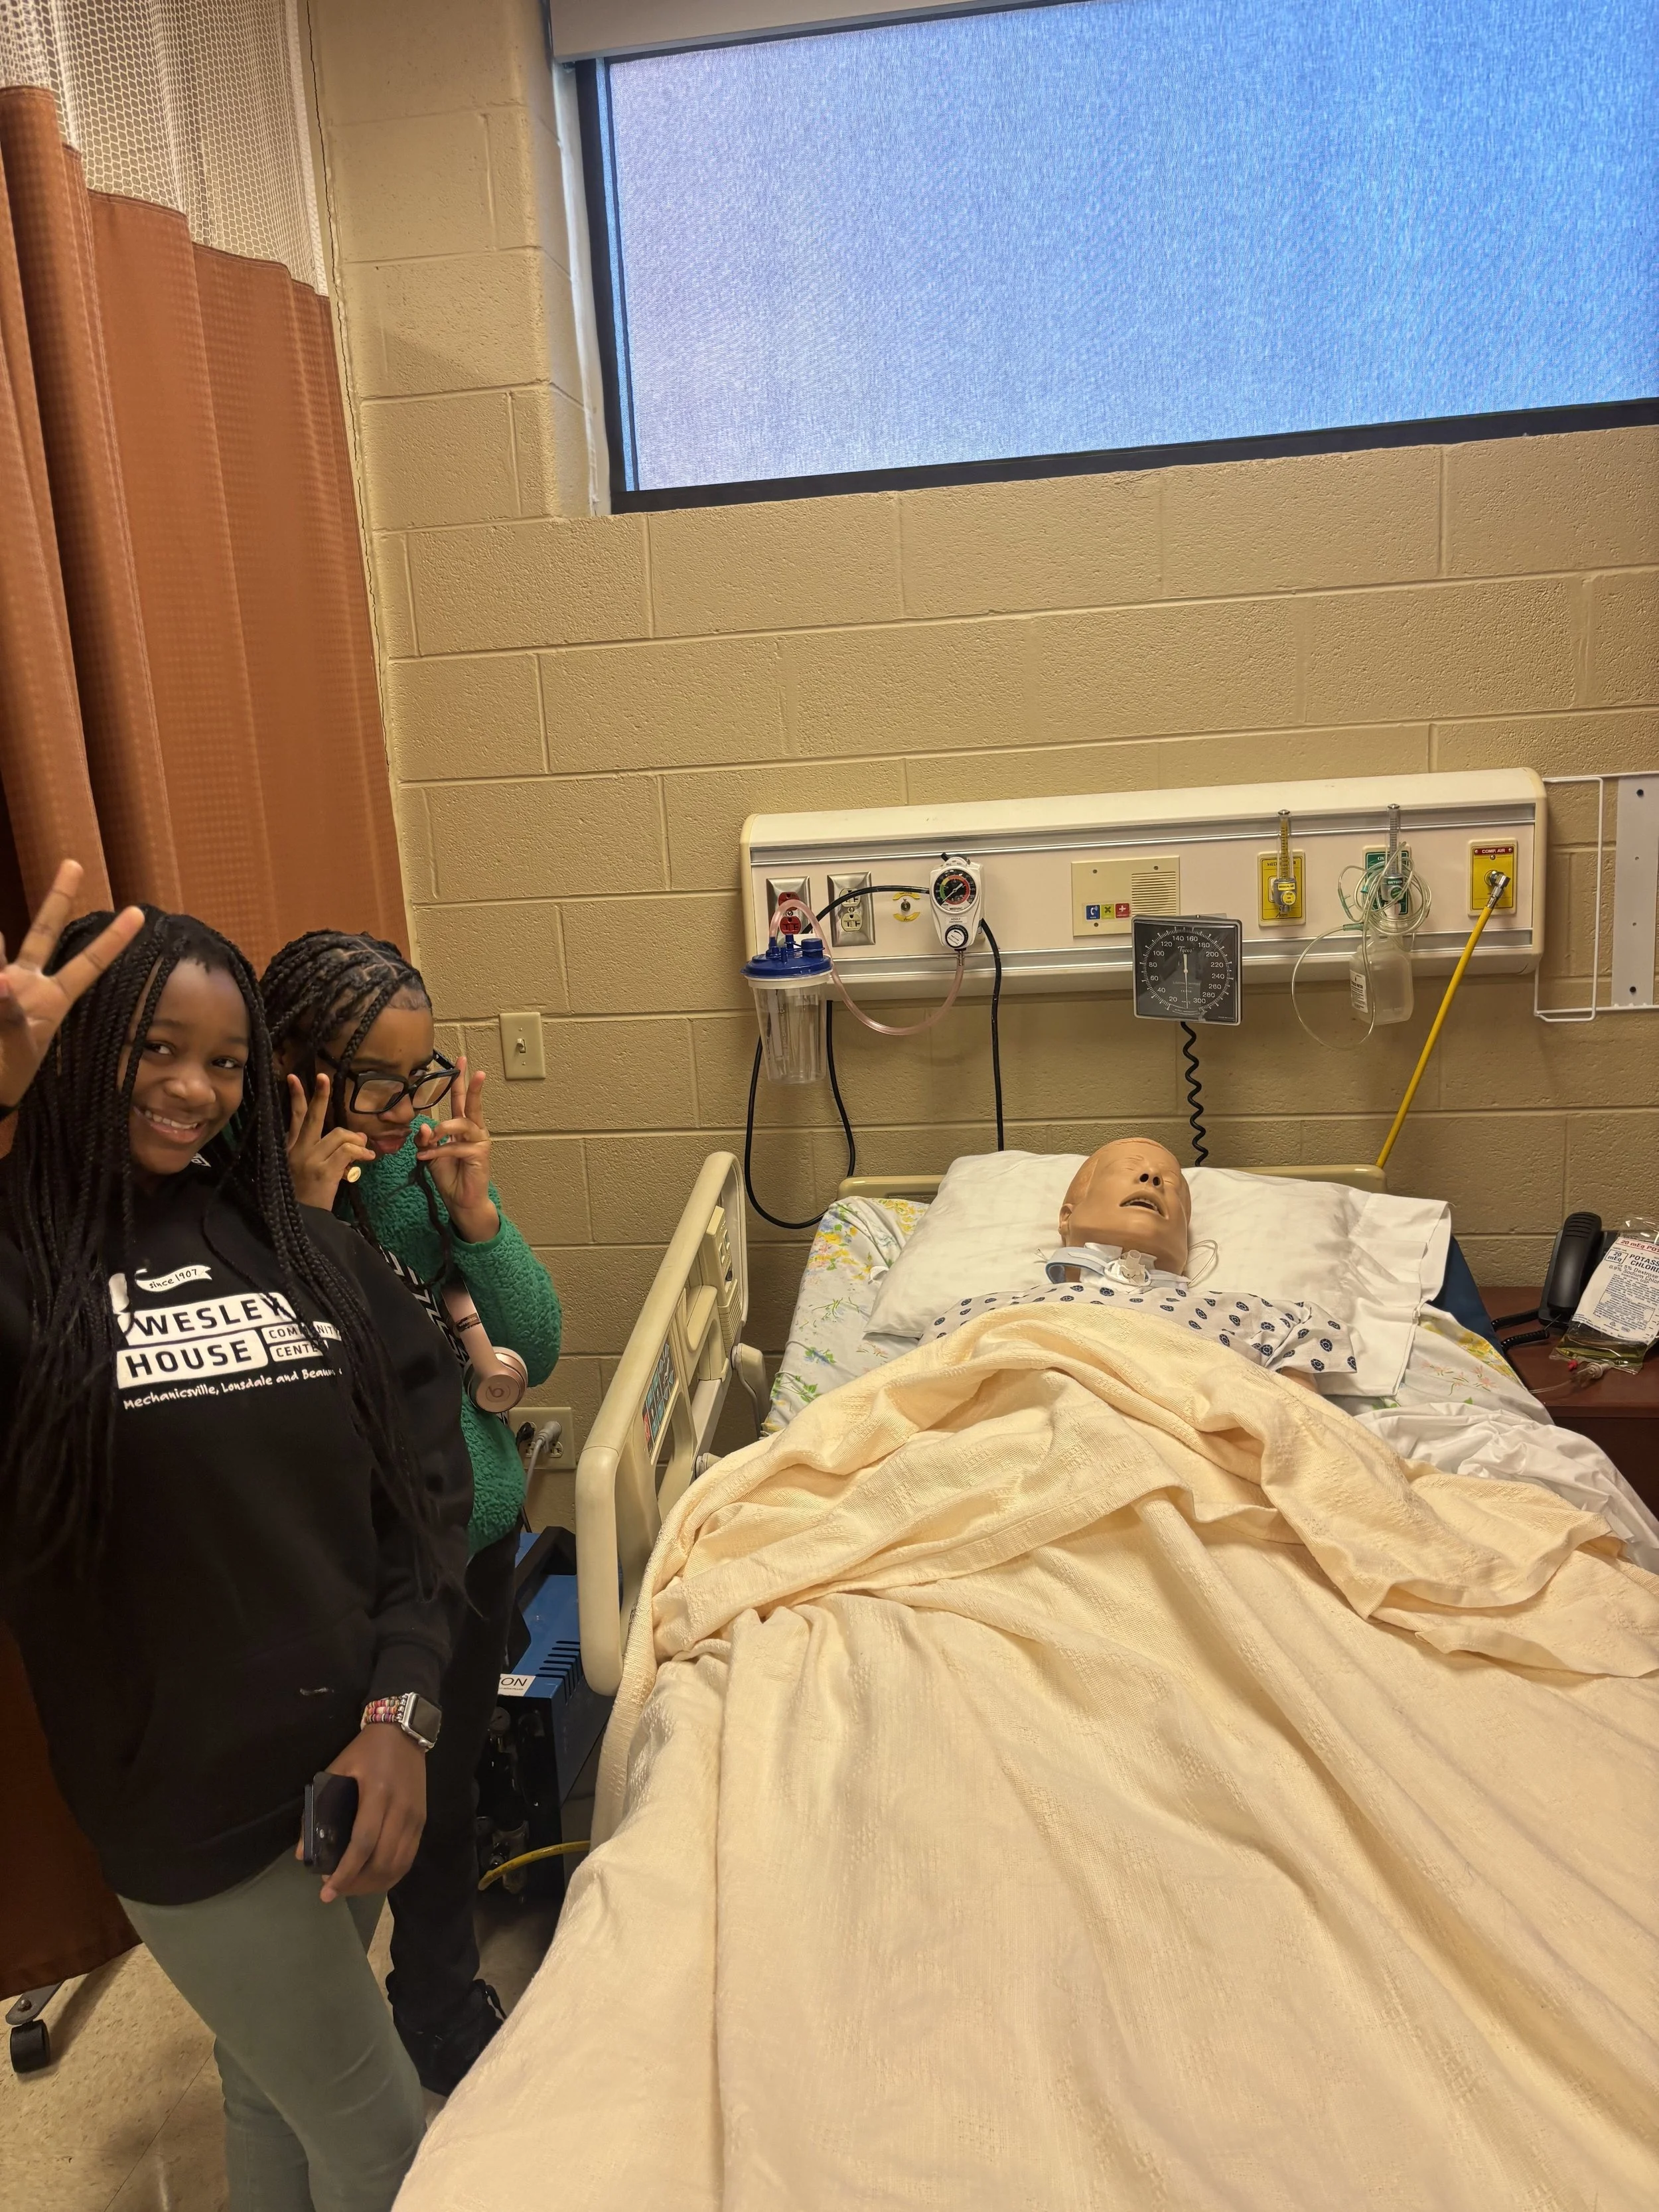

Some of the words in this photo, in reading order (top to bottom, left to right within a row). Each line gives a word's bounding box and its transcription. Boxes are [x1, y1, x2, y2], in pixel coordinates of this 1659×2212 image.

[149, 1278, 175, 1289] since
[175, 1268, 197, 1282] 1907
[1623, 1269, 1644, 1279] Sodium
[133, 1297, 279, 1337] WESLEY
[125, 1339, 252, 1378] HOUSE
[275, 1343, 320, 1358] CENTE
[123, 1383, 220, 1410] Mechanicsville,
[221, 1374, 273, 1394] Lonsdale
[276, 1370, 299, 1384] and
